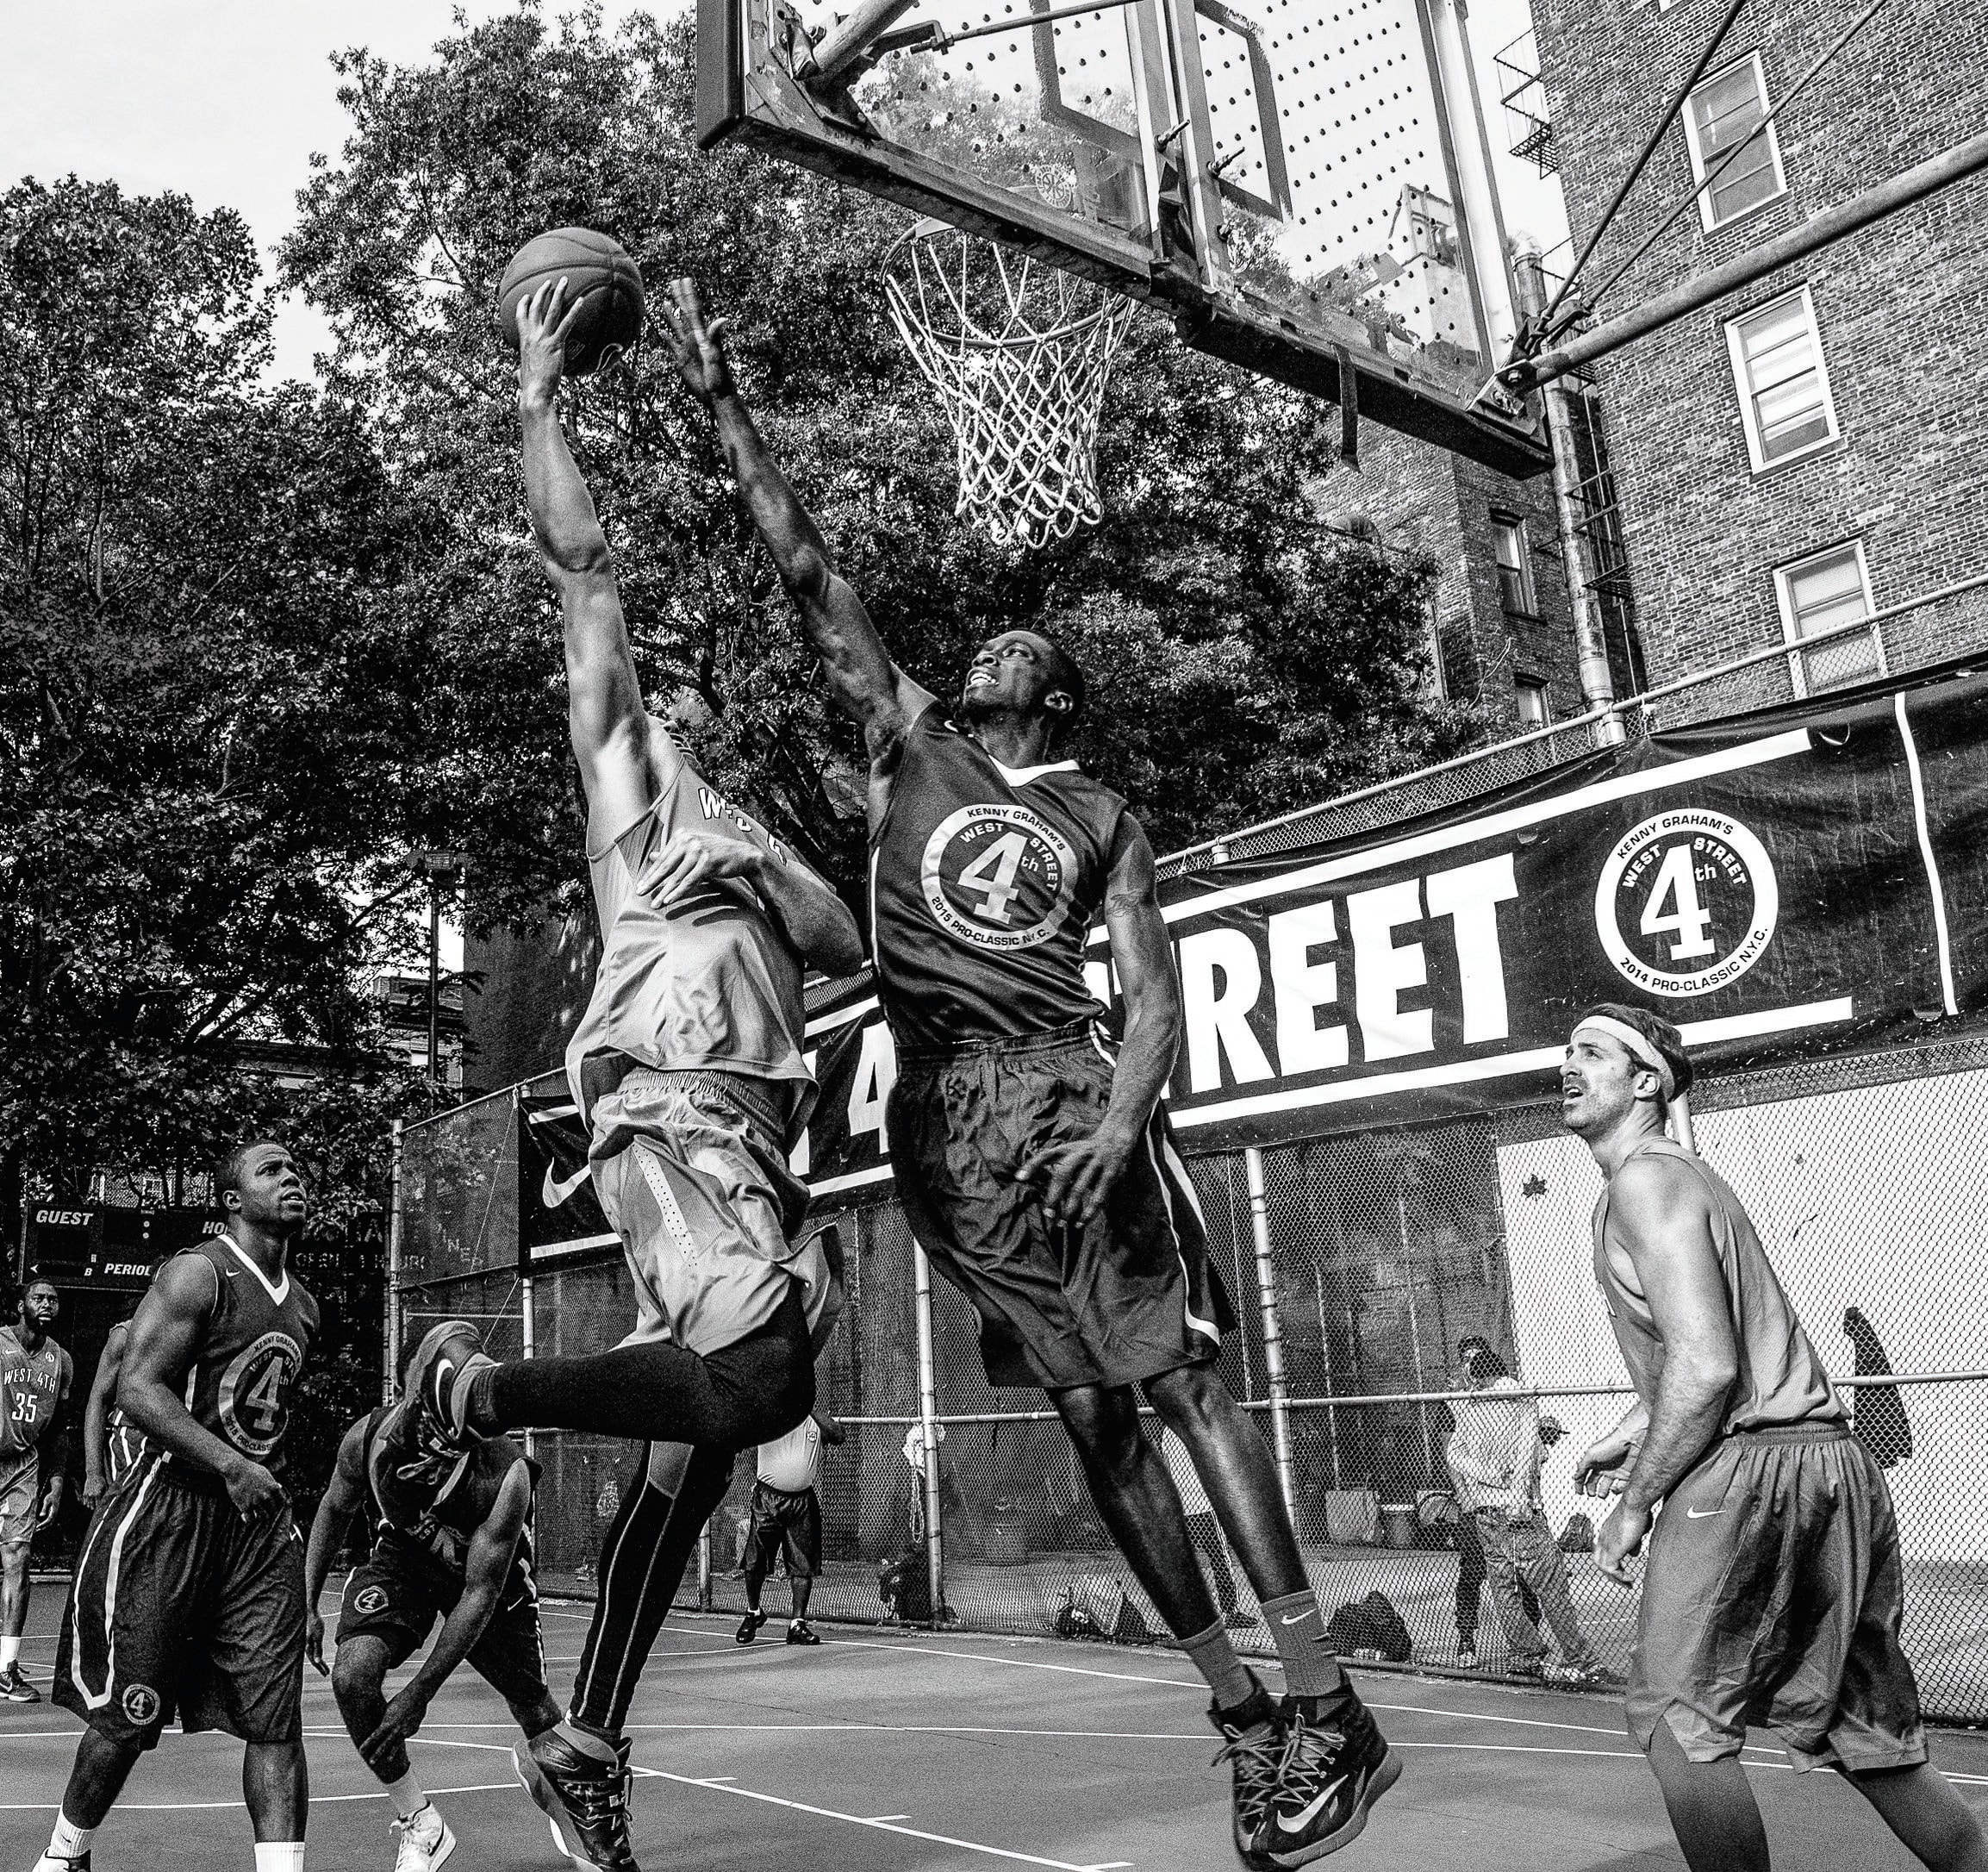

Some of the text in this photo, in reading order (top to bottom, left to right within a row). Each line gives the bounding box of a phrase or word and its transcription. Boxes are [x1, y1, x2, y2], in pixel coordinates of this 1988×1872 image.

[967, 807, 1066, 851] KENNY GRAHAM'S
[1617, 814, 1734, 859] KENNY GRAHAM'S
[959, 821, 1004, 843] WEST
[1029, 837, 1058, 891] STREET
[1622, 844, 1661, 888] WEST
[1693, 837, 1748, 886] STREET
[932, 895, 952, 922] 2015
[950, 920, 1019, 946] PRO-CLASSIC
[1081, 852, 1519, 1100] REET
[1620, 927, 1768, 992] 2014 PRO-CLASSIC N.Y.C.
[36, 1209, 94, 1226] GUEST
[202, 1220, 228, 1234] HO
[84, 1267, 93, 1276] B
[3, 1368, 56, 1395] WEST 4TH
[11, 1392, 38, 1423] 35
